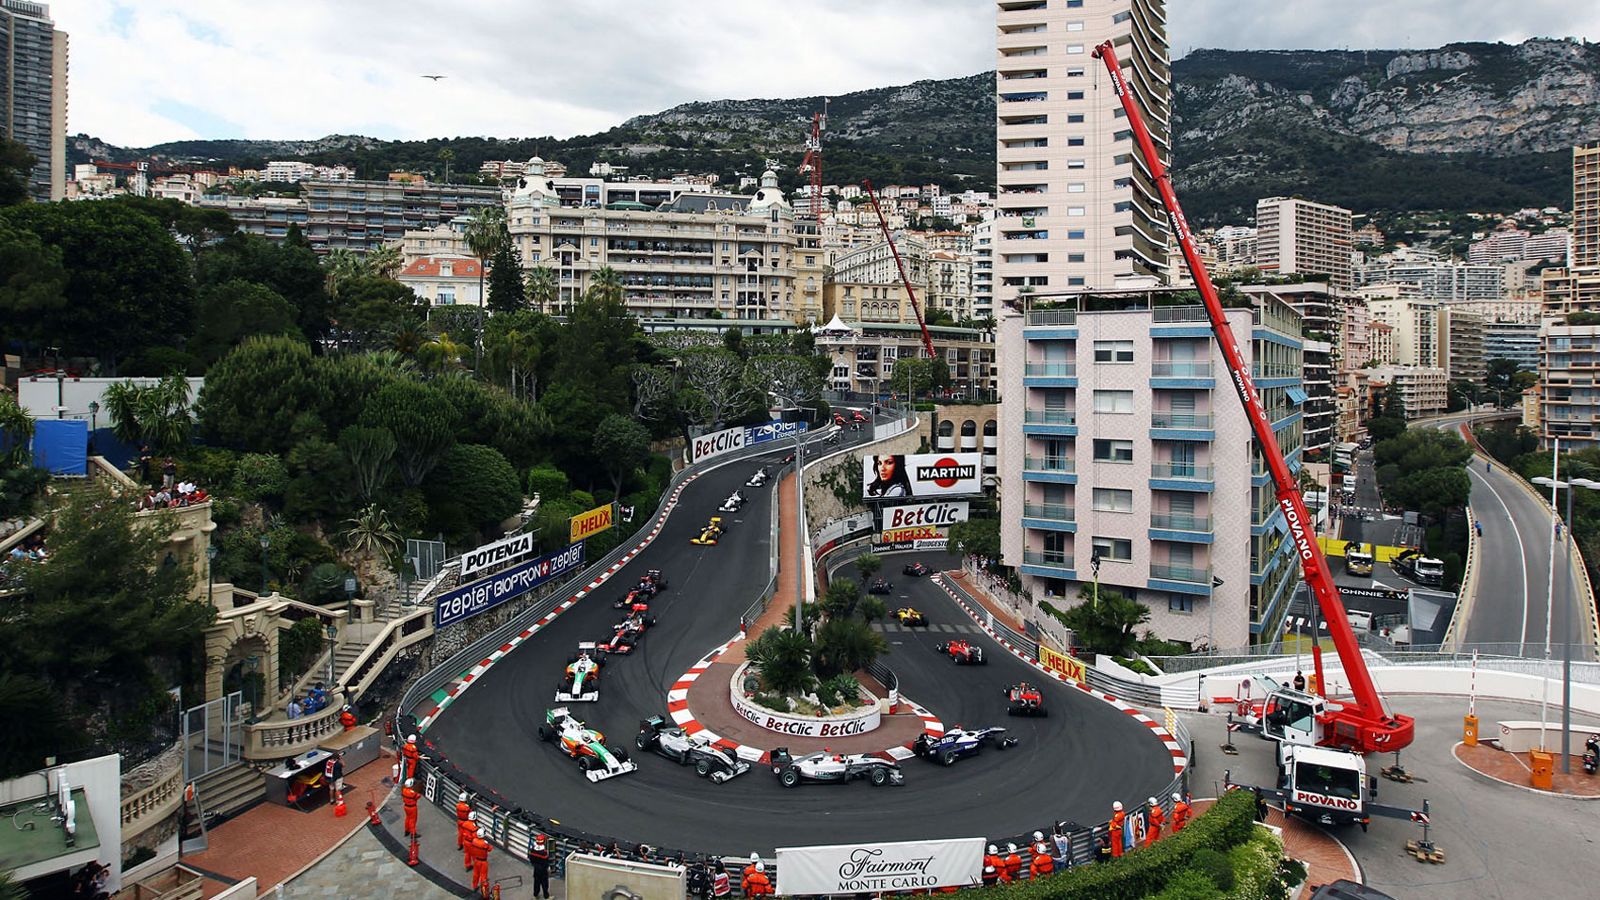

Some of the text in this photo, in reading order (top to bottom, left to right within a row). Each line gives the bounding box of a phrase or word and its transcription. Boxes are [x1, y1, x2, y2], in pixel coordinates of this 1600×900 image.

[1234, 369, 1250, 402] PIOVANO
[695, 429, 741, 459] BetClic
[920, 467, 973, 479] MARTINI
[580, 509, 610, 535] HELIX
[891, 503, 959, 528] BetClic
[893, 527, 933, 542] HELIX
[1281, 499, 1313, 560] PIOVANO
[465, 537, 530, 571] POTENZA
[551, 545, 583, 571] zepter
[441, 565, 542, 619] zepter BIOPTRON
[1338, 587, 1384, 598] JOHNNIE
[1047, 652, 1082, 681] HELIX
[735, 702, 760, 724] BetClic
[765, 717, 813, 736] BetClic
[820, 720, 866, 736] BetClic
[1297, 792, 1358, 810] PIOVANO
[838, 848, 936, 880] Fairmont
[837, 875, 938, 891] MONTE CARLO
